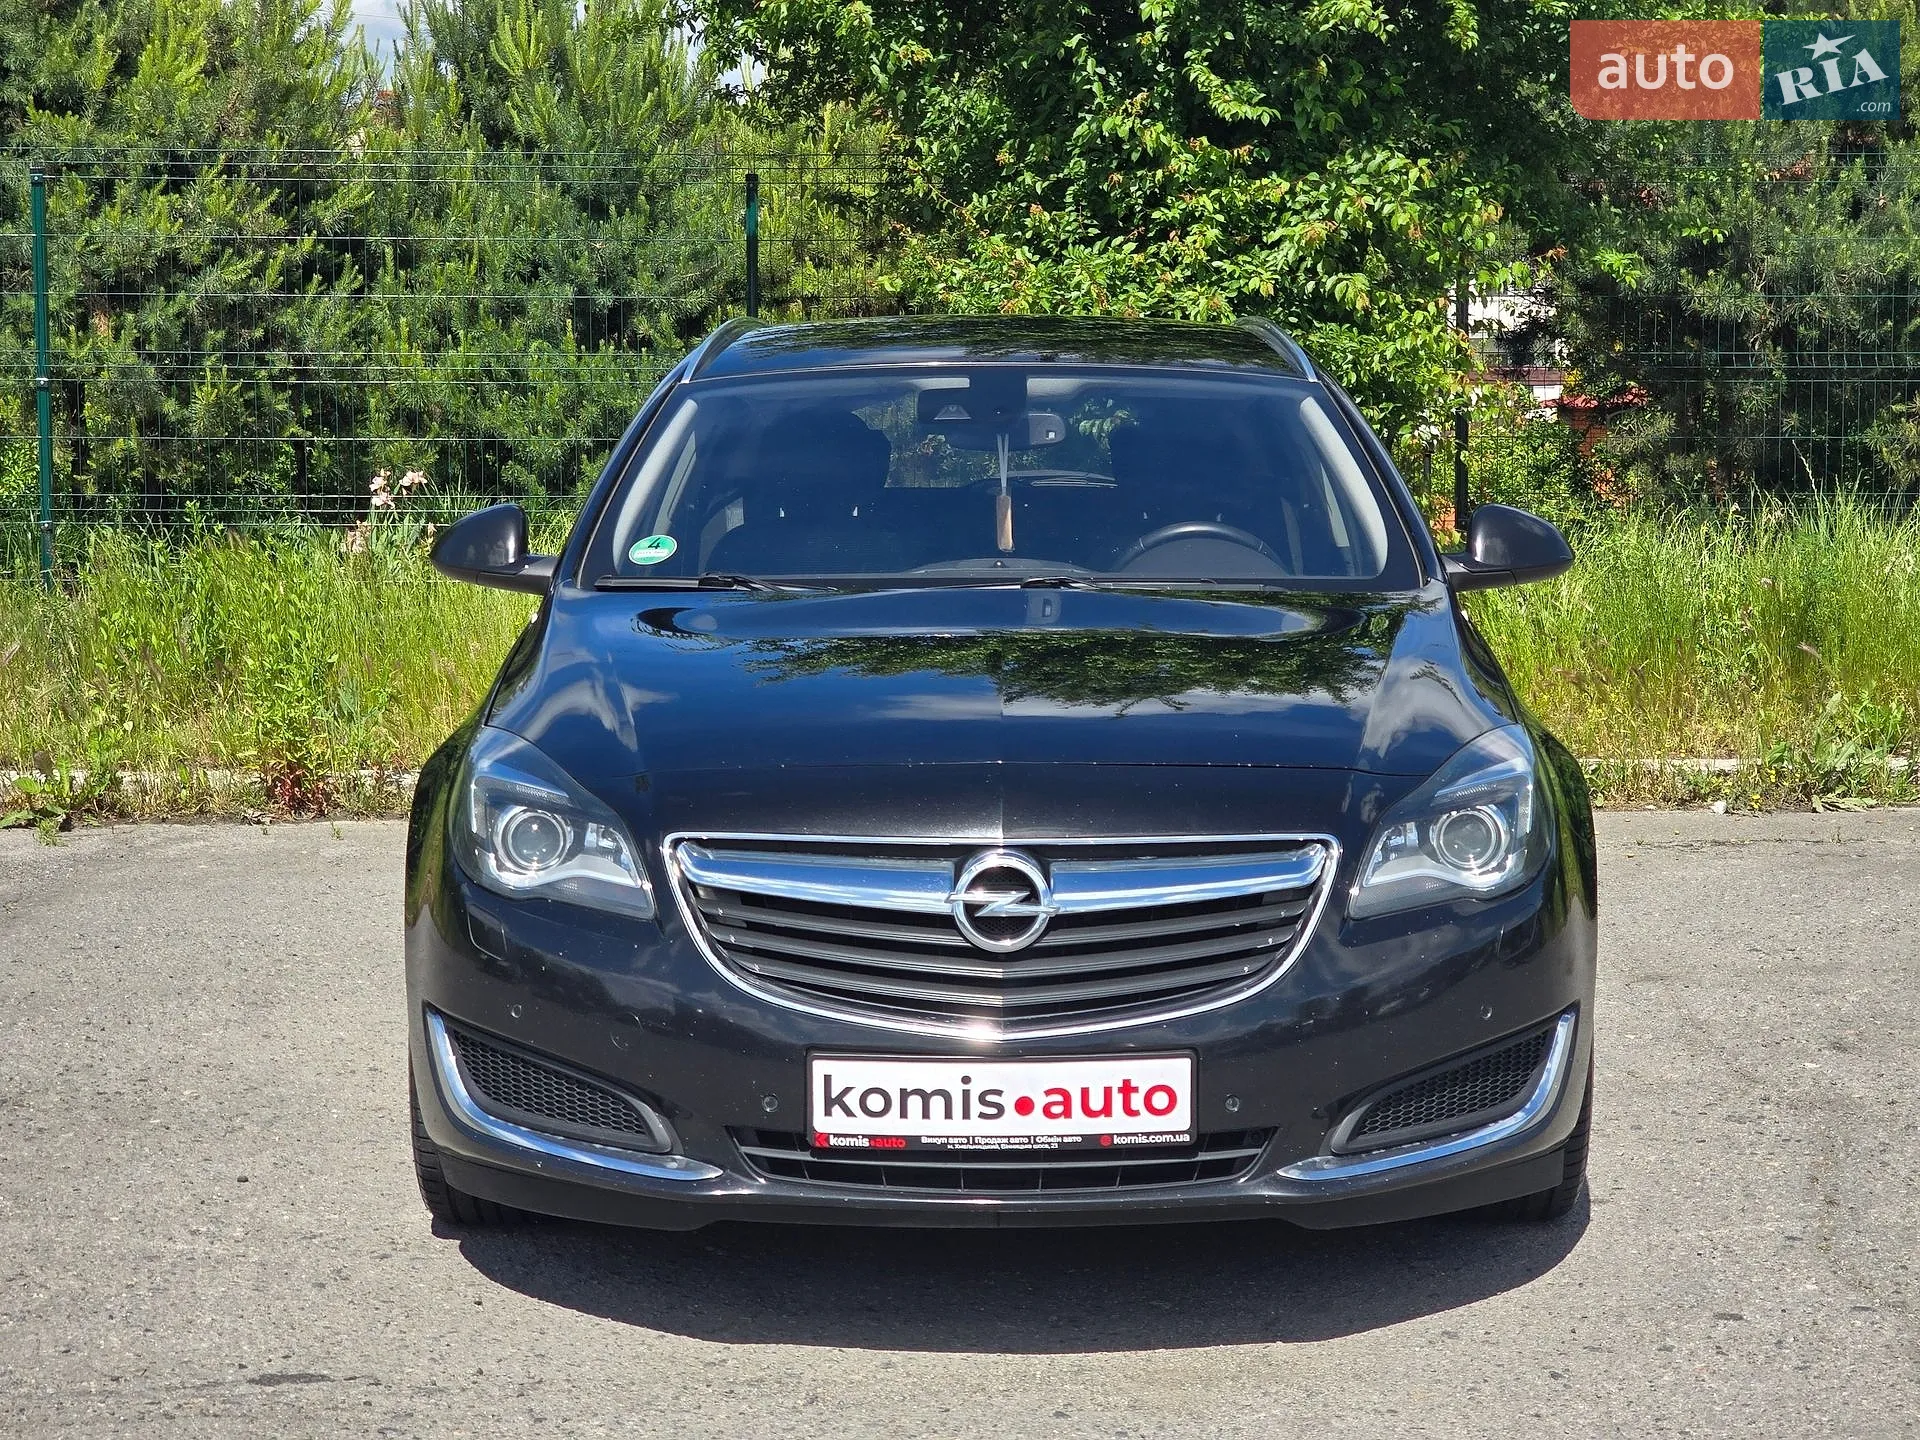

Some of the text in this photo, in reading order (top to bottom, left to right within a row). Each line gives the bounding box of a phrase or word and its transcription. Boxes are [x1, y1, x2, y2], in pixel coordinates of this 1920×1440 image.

[648, 538, 660, 549] 4
[948, 1136, 968, 1144] авто
[1009, 1136, 1029, 1144] авто
[1063, 1135, 1083, 1143] авто
[1113, 1133, 1190, 1145] komis.com.ua
